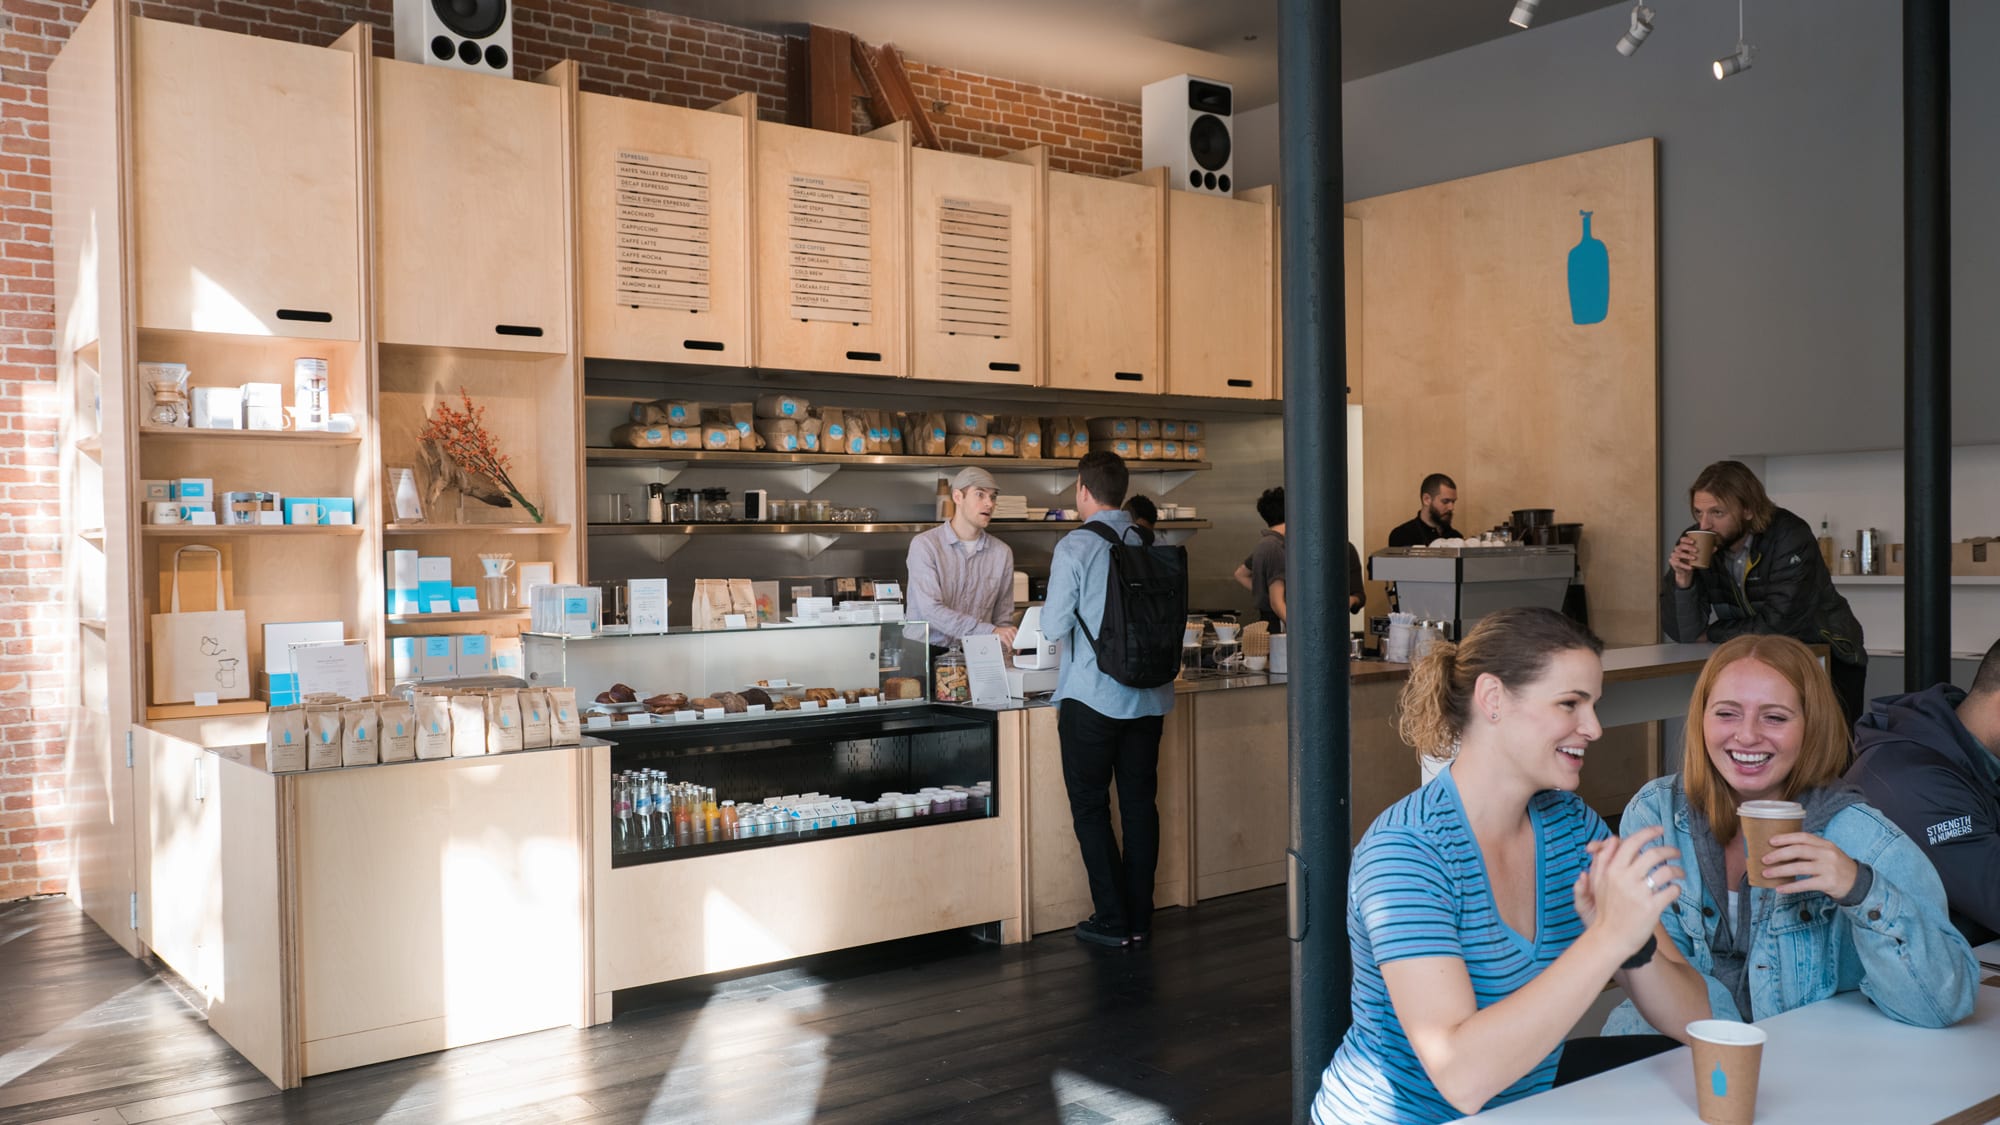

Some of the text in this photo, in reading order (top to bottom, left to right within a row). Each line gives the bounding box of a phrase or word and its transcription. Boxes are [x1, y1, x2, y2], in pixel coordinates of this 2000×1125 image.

[620, 152, 648, 161] ESPRESSO
[660, 172, 688, 180] ESPRESSO
[640, 182, 670, 190] ESPRESSO
[662, 200, 690, 208] ESPRESSO
[794, 216, 823, 224] GUATEMALA
[622, 224, 658, 232] CAPPUCCINO
[634, 267, 668, 276] CHOCOLATE
[1926, 814, 1972, 836] STRENGTH
[1928, 824, 1972, 846] IN NUMBERS
